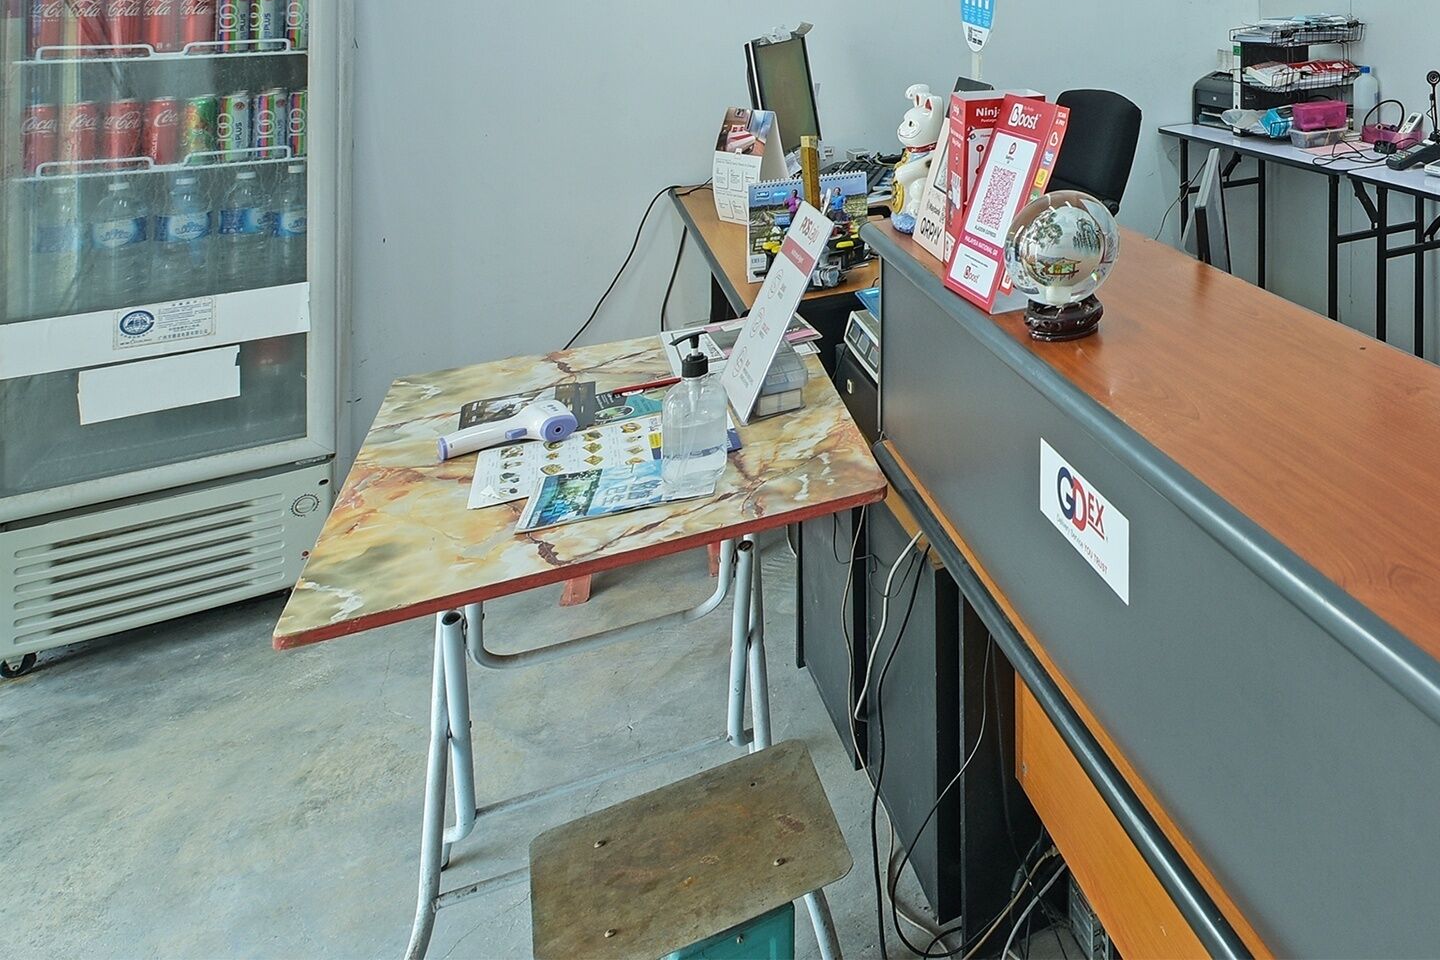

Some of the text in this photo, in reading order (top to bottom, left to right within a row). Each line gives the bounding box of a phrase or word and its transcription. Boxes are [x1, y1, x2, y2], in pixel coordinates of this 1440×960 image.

[256, 110, 275, 138] 100
[976, 106, 1000, 118] Ninj
[1008, 103, 1040, 130] Boost
[1057, 466, 1105, 533] GDEX
